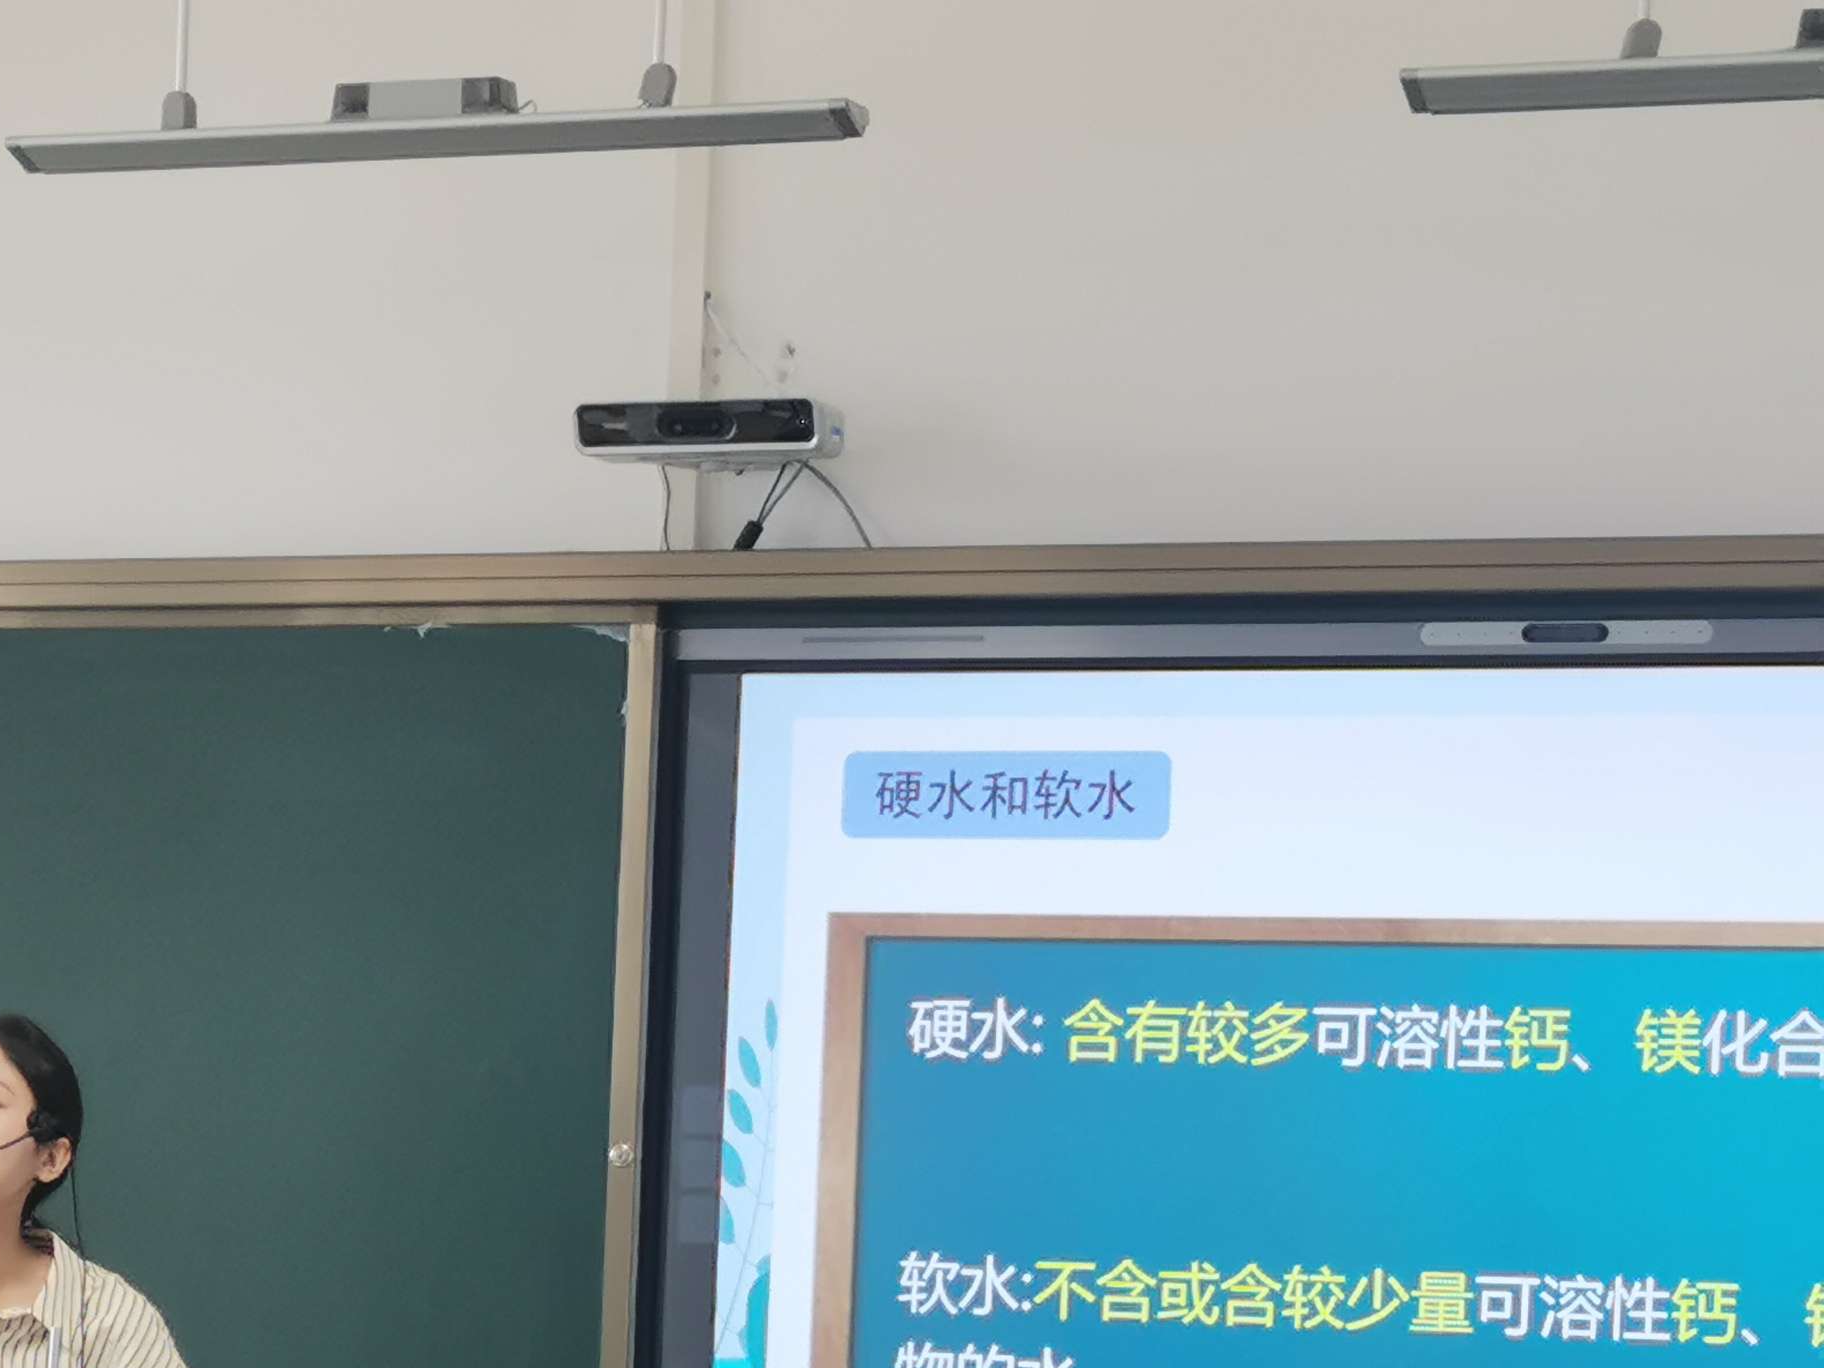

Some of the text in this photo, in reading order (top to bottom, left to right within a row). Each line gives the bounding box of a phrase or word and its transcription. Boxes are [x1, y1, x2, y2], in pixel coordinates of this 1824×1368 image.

[874, 767, 1138, 824] 硬水和软水
